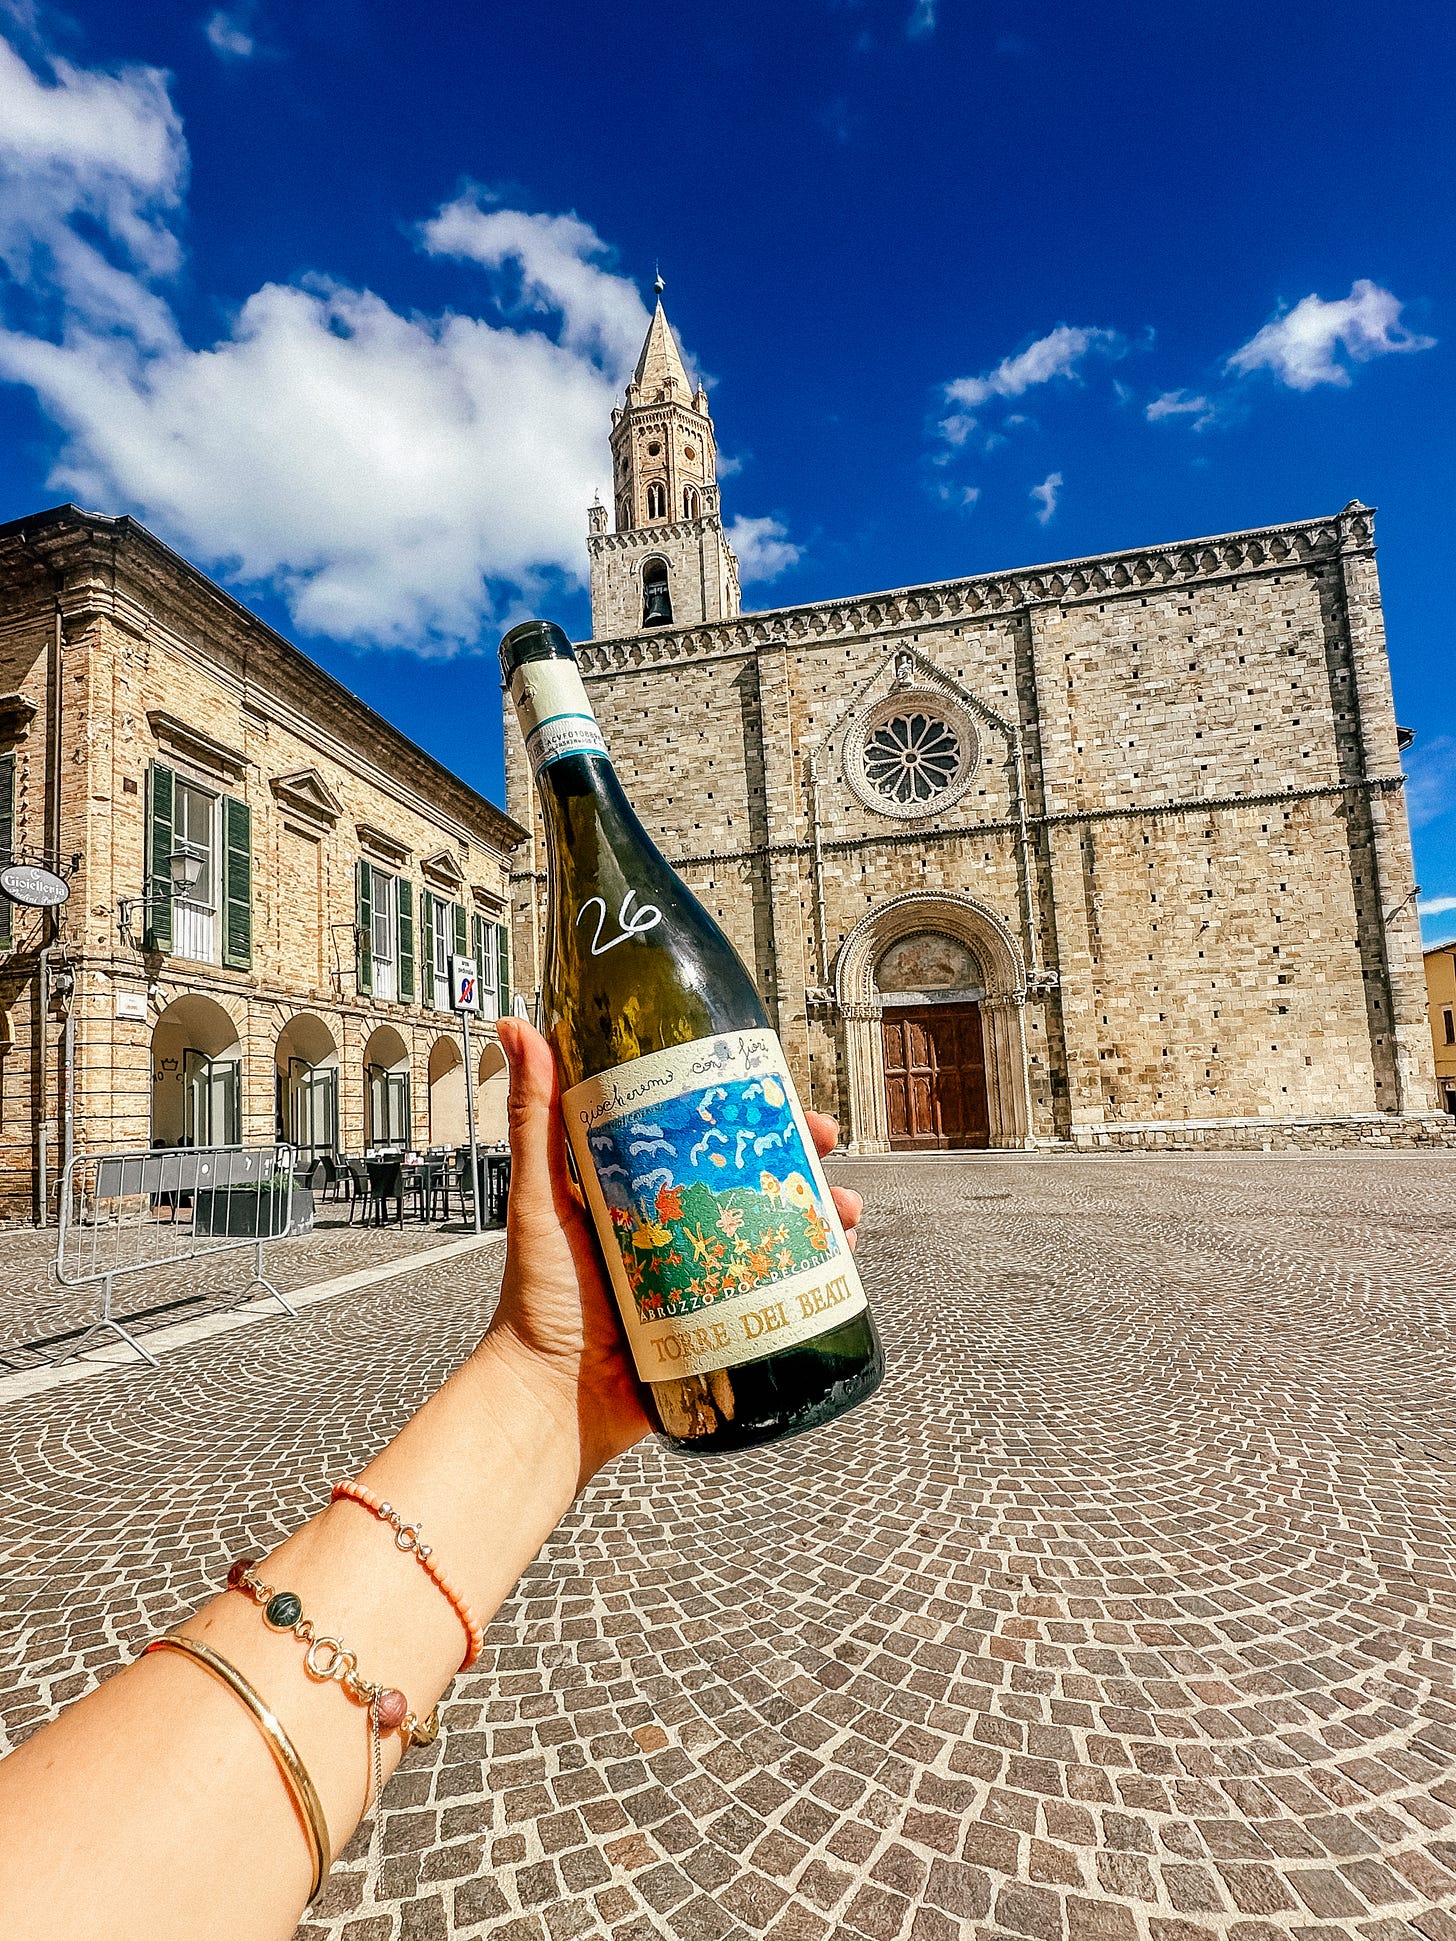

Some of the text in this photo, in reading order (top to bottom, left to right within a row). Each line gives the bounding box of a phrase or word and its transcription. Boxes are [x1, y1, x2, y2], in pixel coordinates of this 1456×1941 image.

[4, 875, 65, 896] Gioielleria
[576, 889, 662, 955] 26
[692, 1060, 723, 1074] con
[738, 1036, 769, 1071] fiori
[639, 1293, 715, 1324] ABRUZZO
[723, 1279, 763, 1301] DOC
[650, 1274, 853, 1363] TORRE DEI BEATI
